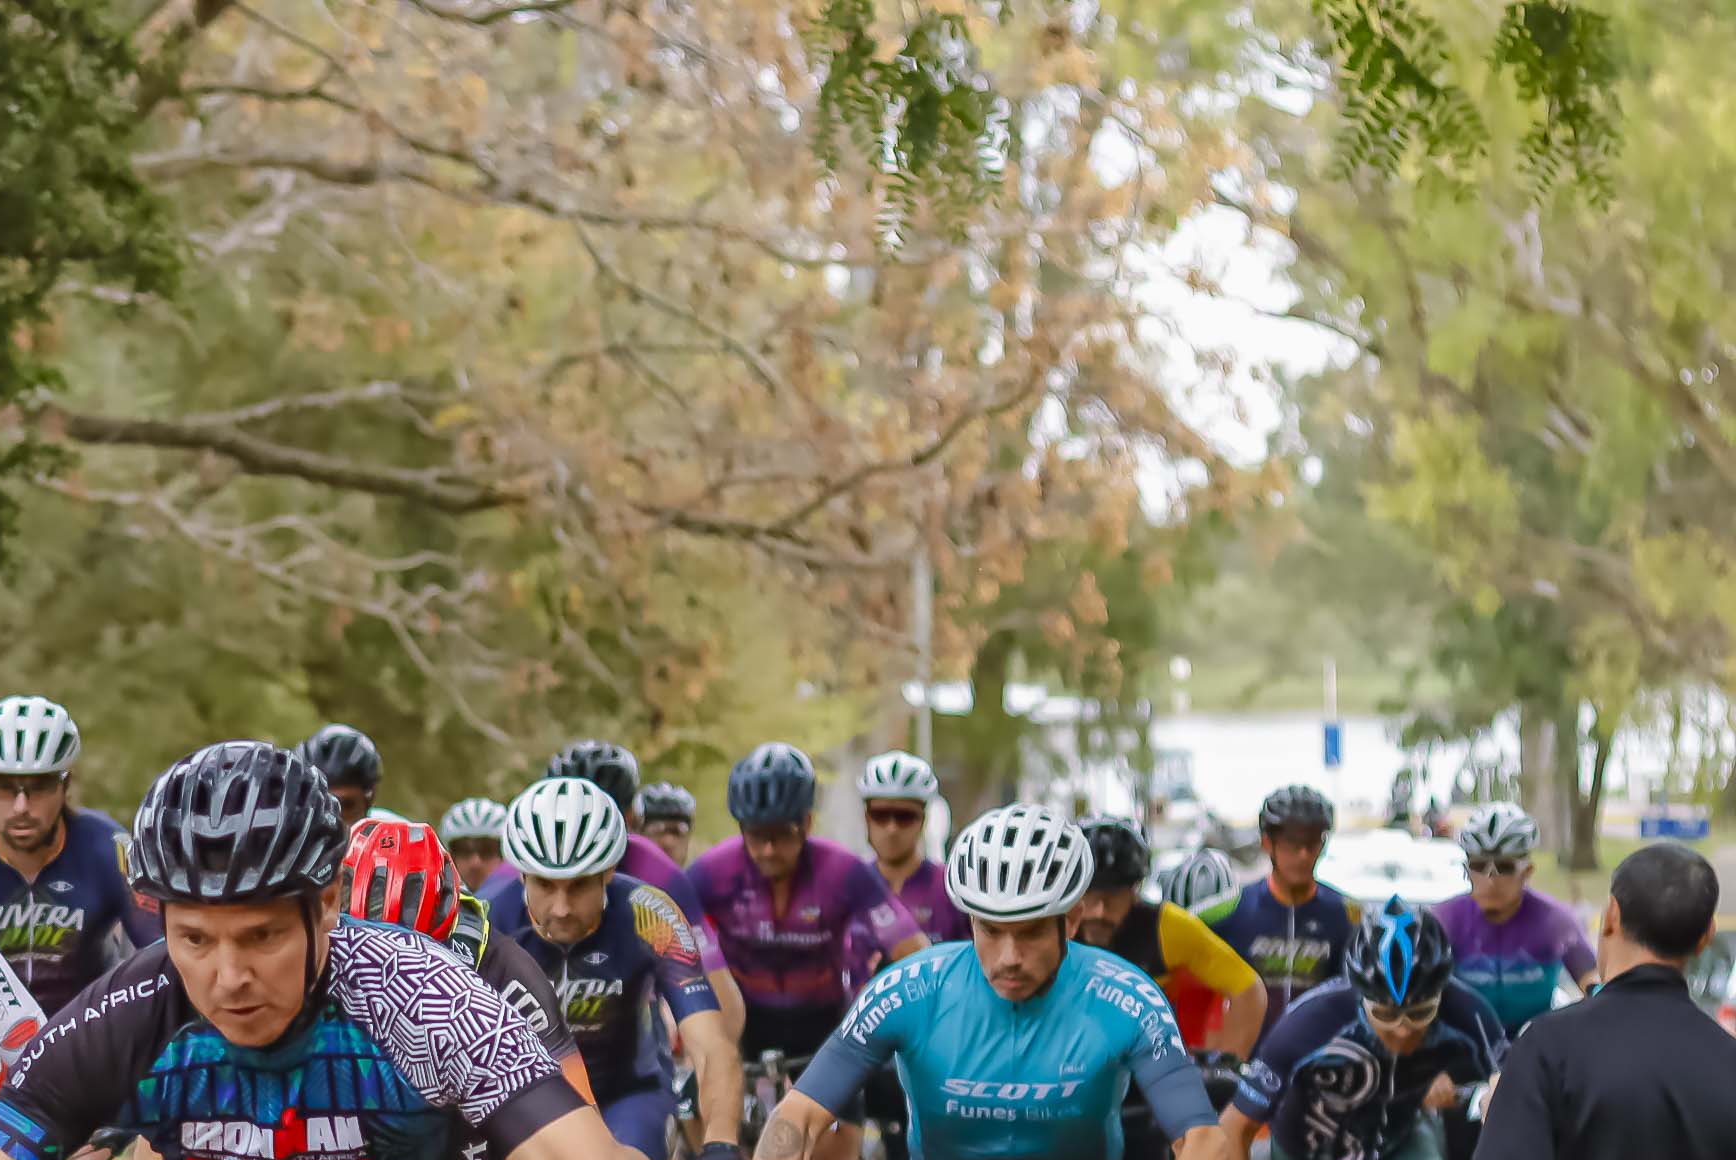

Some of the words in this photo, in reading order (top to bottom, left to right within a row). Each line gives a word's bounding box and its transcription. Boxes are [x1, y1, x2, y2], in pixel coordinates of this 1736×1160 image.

[1085, 979, 1144, 1020] Funes
[941, 1078, 1085, 1101] SCOTT
[946, 1099, 1018, 1122] Funes
